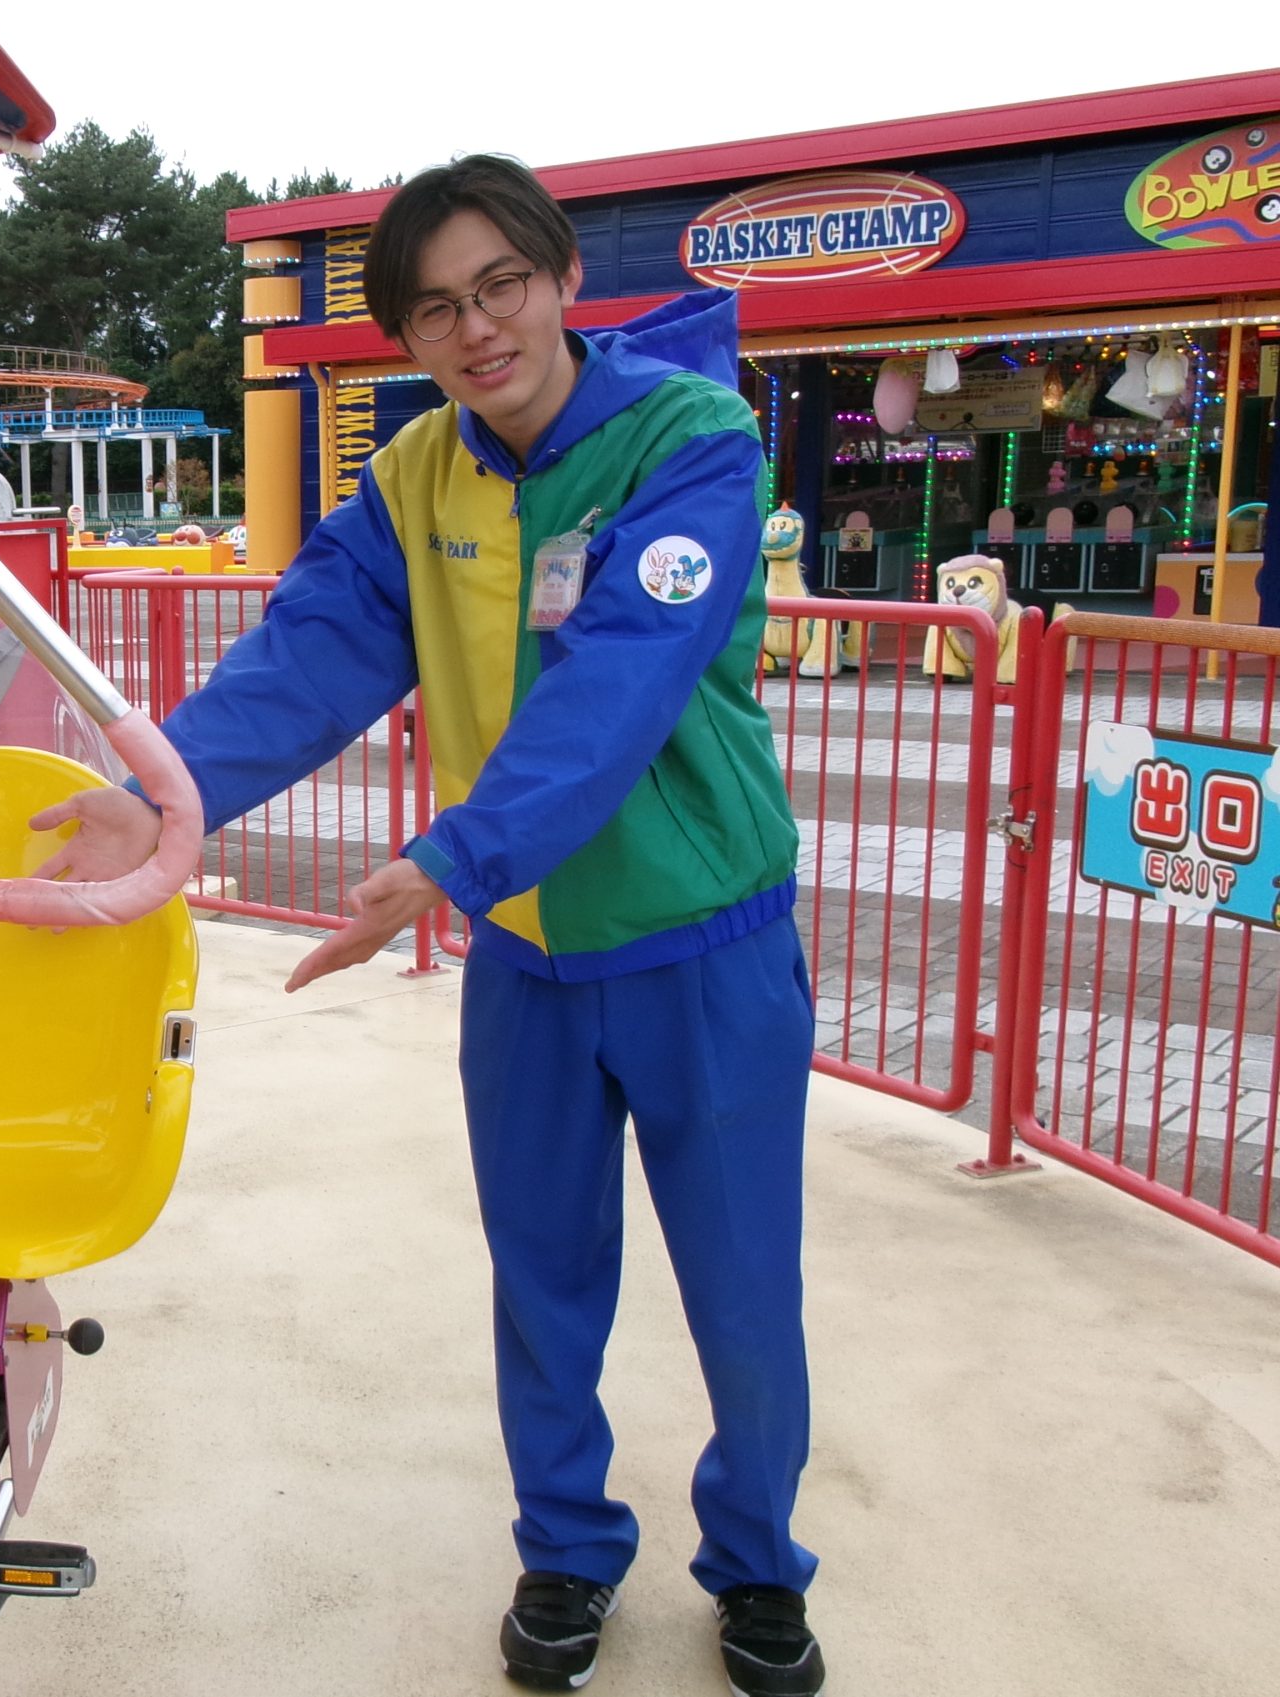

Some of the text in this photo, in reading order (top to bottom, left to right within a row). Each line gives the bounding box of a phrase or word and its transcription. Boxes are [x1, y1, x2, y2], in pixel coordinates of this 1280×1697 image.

[687, 199, 951, 268] BASKET CHAMP
[447, 541, 479, 559] PARK
[1133, 761, 1260, 857] 出口
[1147, 852, 1235, 902] EXIT
